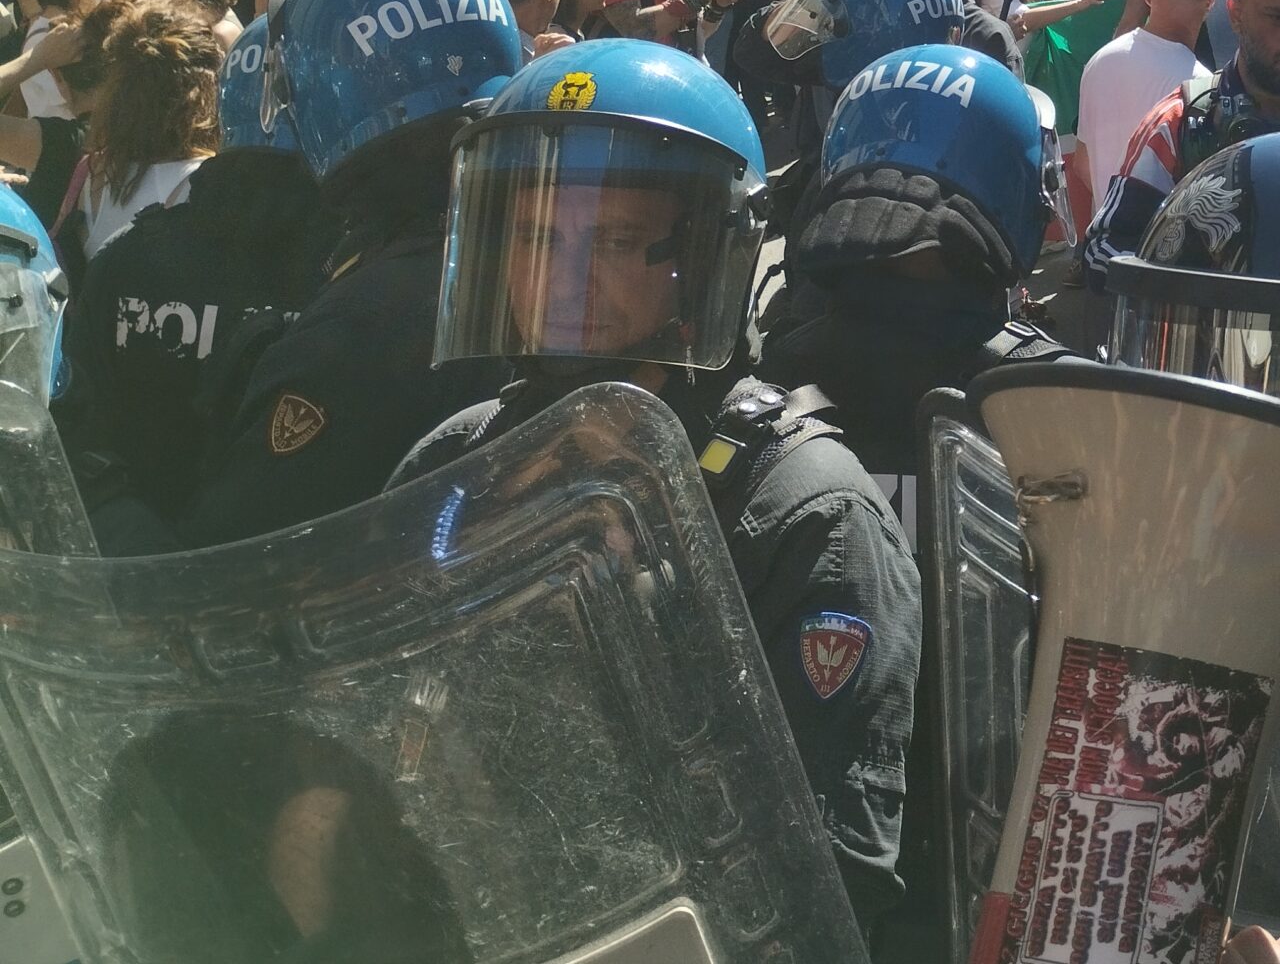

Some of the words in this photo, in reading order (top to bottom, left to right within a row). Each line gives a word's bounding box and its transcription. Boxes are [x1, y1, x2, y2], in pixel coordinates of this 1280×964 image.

[837, 60, 976, 109] OLIZIA
[803, 638, 821, 683] REPARTO
[1076, 746, 1111, 786] NON
